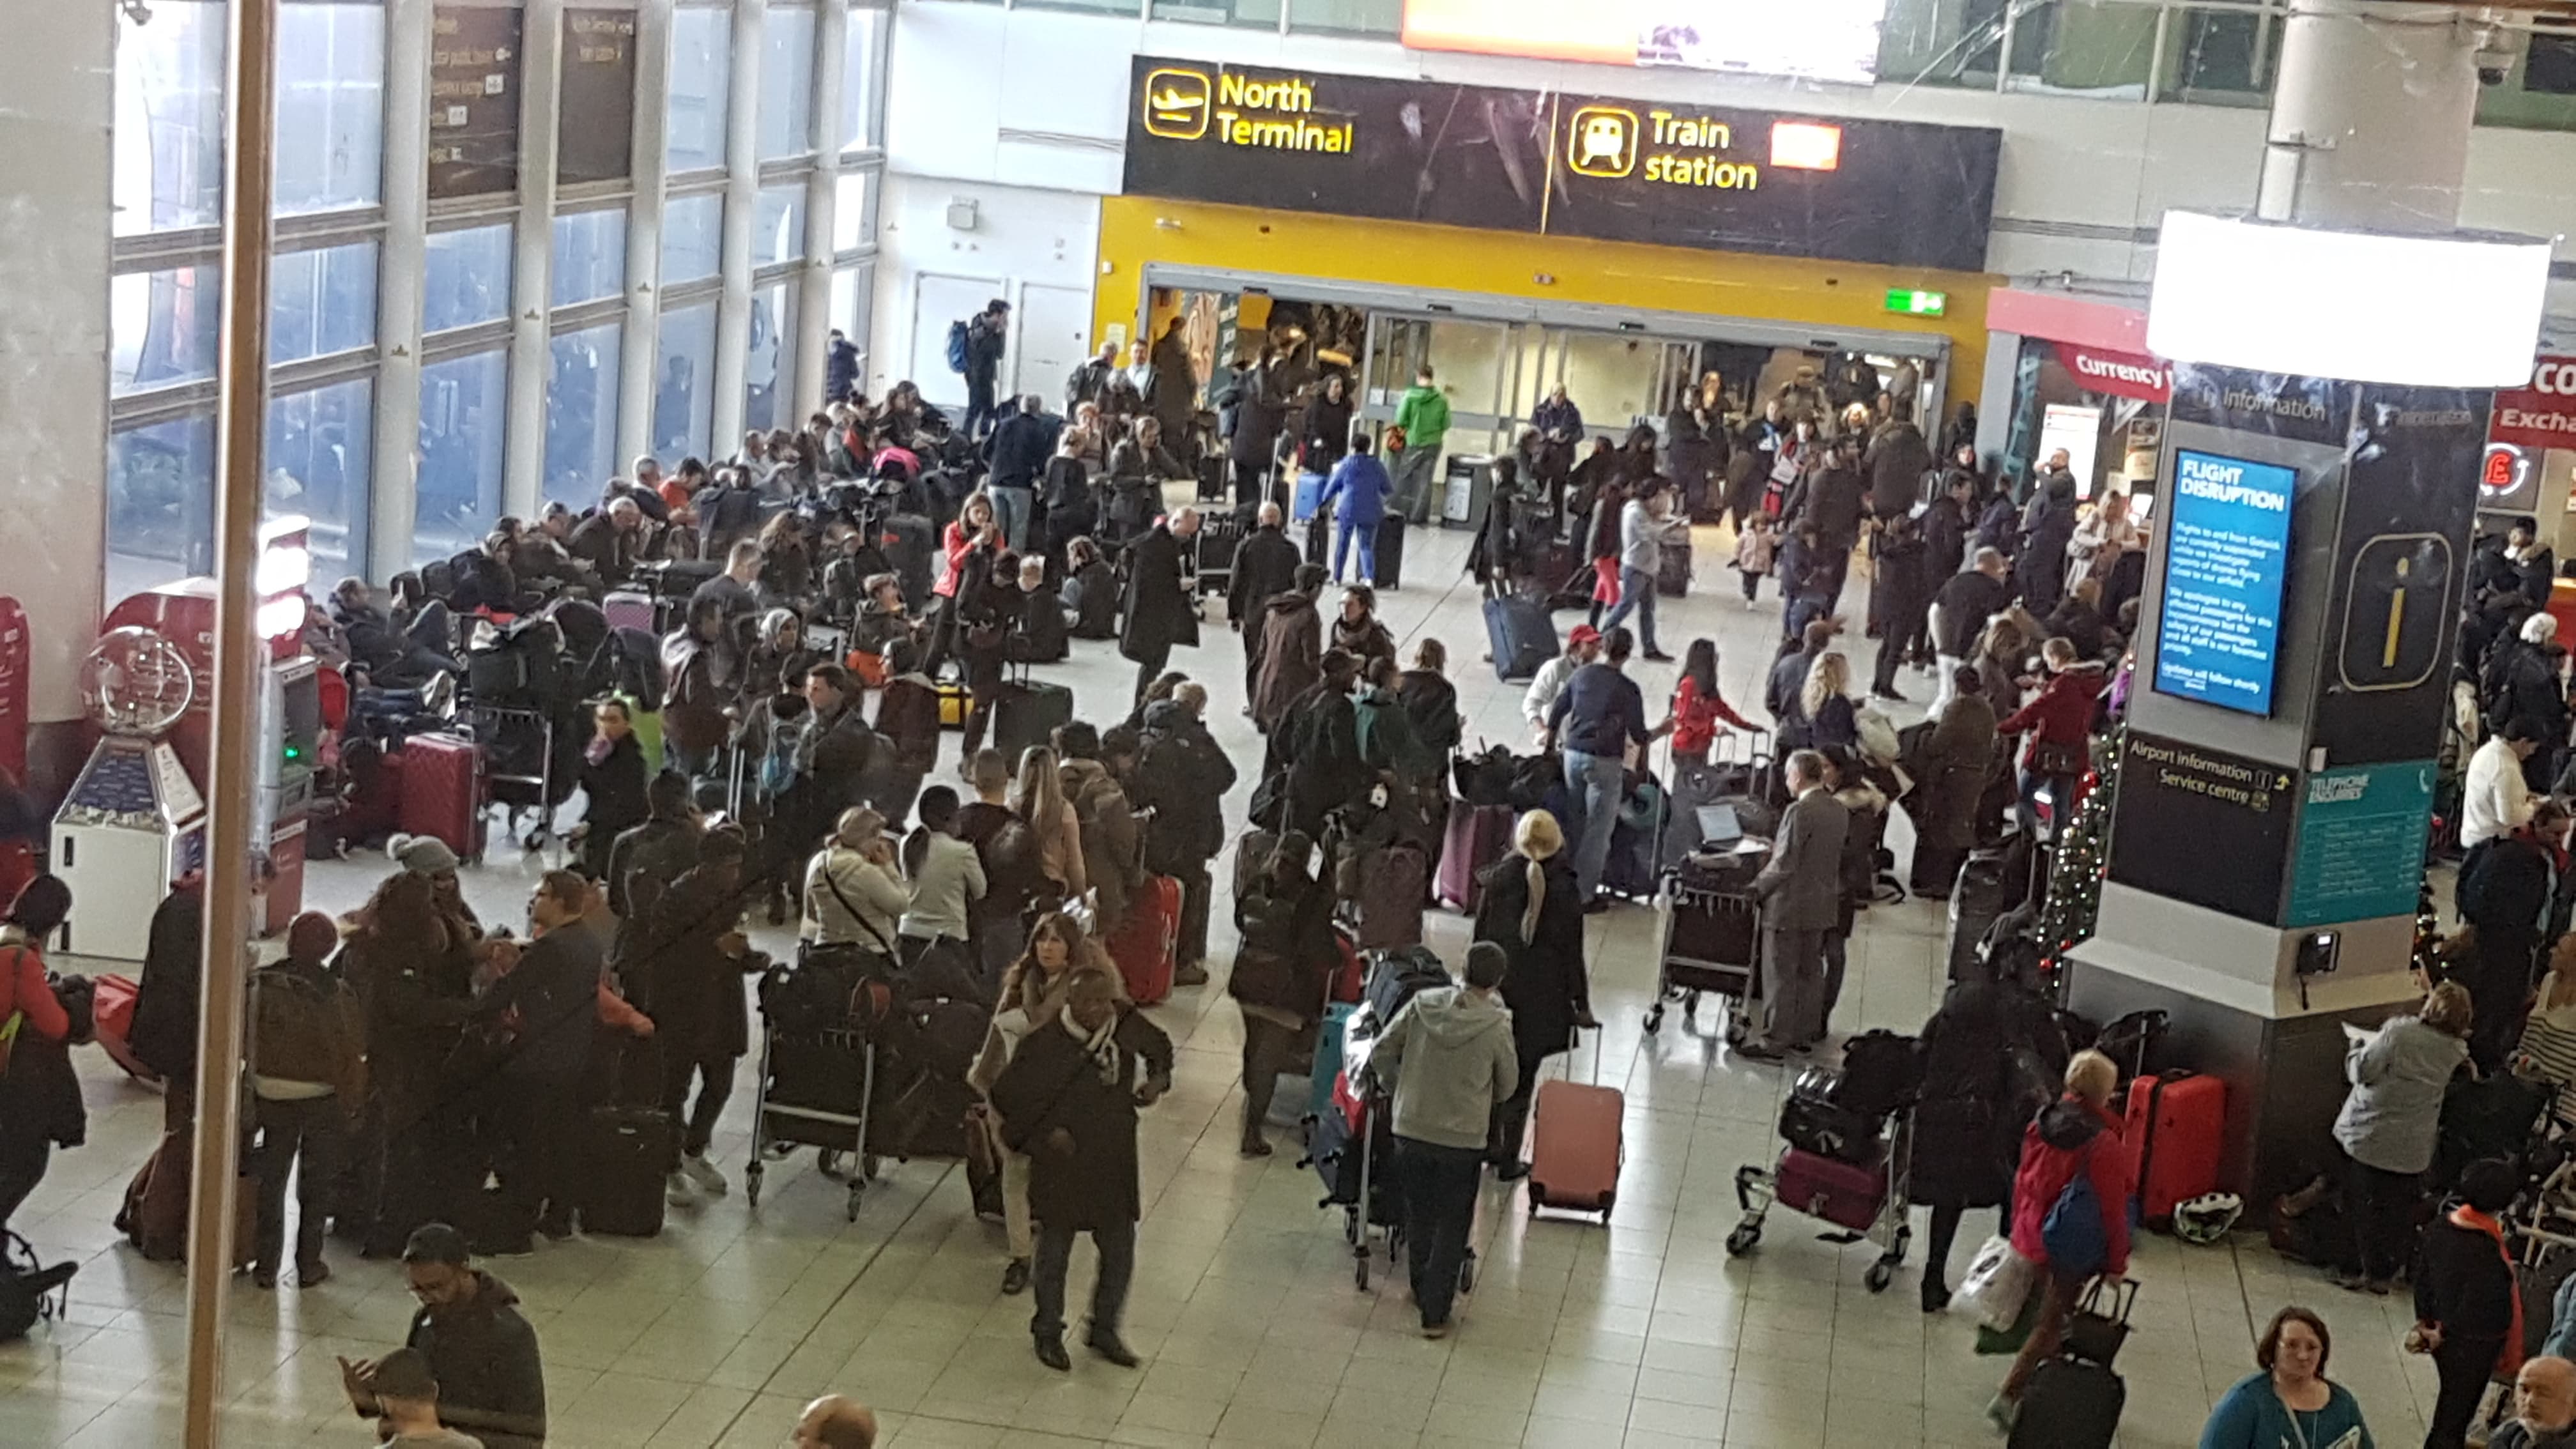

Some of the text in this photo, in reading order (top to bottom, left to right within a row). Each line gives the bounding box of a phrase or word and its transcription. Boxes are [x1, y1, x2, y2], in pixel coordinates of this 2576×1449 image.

[1220, 74, 1312, 112] North
[1216, 111, 1353, 153] Terminal
[1650, 111, 1729, 149] Train
[1644, 155, 1757, 190] station
[2076, 355, 2162, 388] Currency
[2223, 387, 2326, 421] Information
[2182, 459, 2242, 486] FLIGHT
[2180, 477, 2284, 510] DISRUPTION
[2130, 740, 2253, 783] Airport information
[2160, 769, 2250, 803] Service centre
